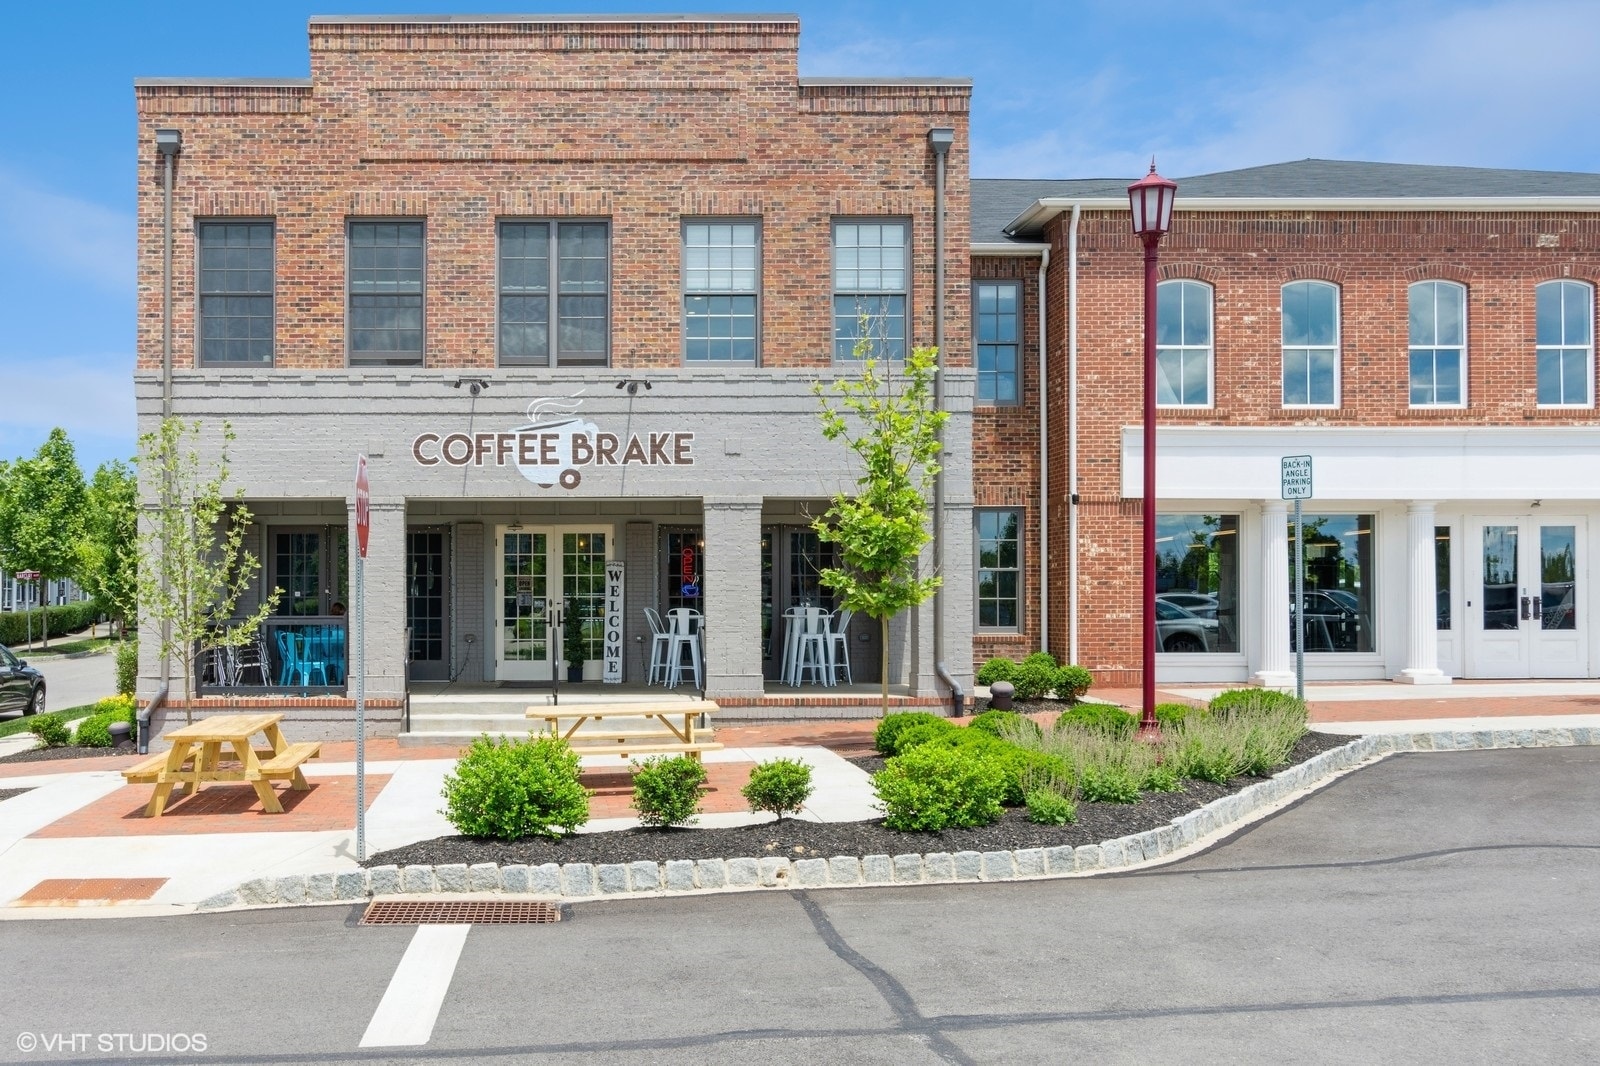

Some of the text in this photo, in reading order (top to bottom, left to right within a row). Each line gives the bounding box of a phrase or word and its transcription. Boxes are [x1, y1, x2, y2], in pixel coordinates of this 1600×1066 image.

[412, 432, 695, 467] COFFEE BRAKE
[1283, 461, 1310, 469] BACK-IN
[1286, 469, 1308, 477] ANGLE
[1283, 478, 1311, 486] PARKING
[1287, 487, 1306, 495] ONLY
[357, 487, 369, 528] STOP
[683, 548, 694, 583] OPEN
[605, 570, 623, 673] WELCOME
